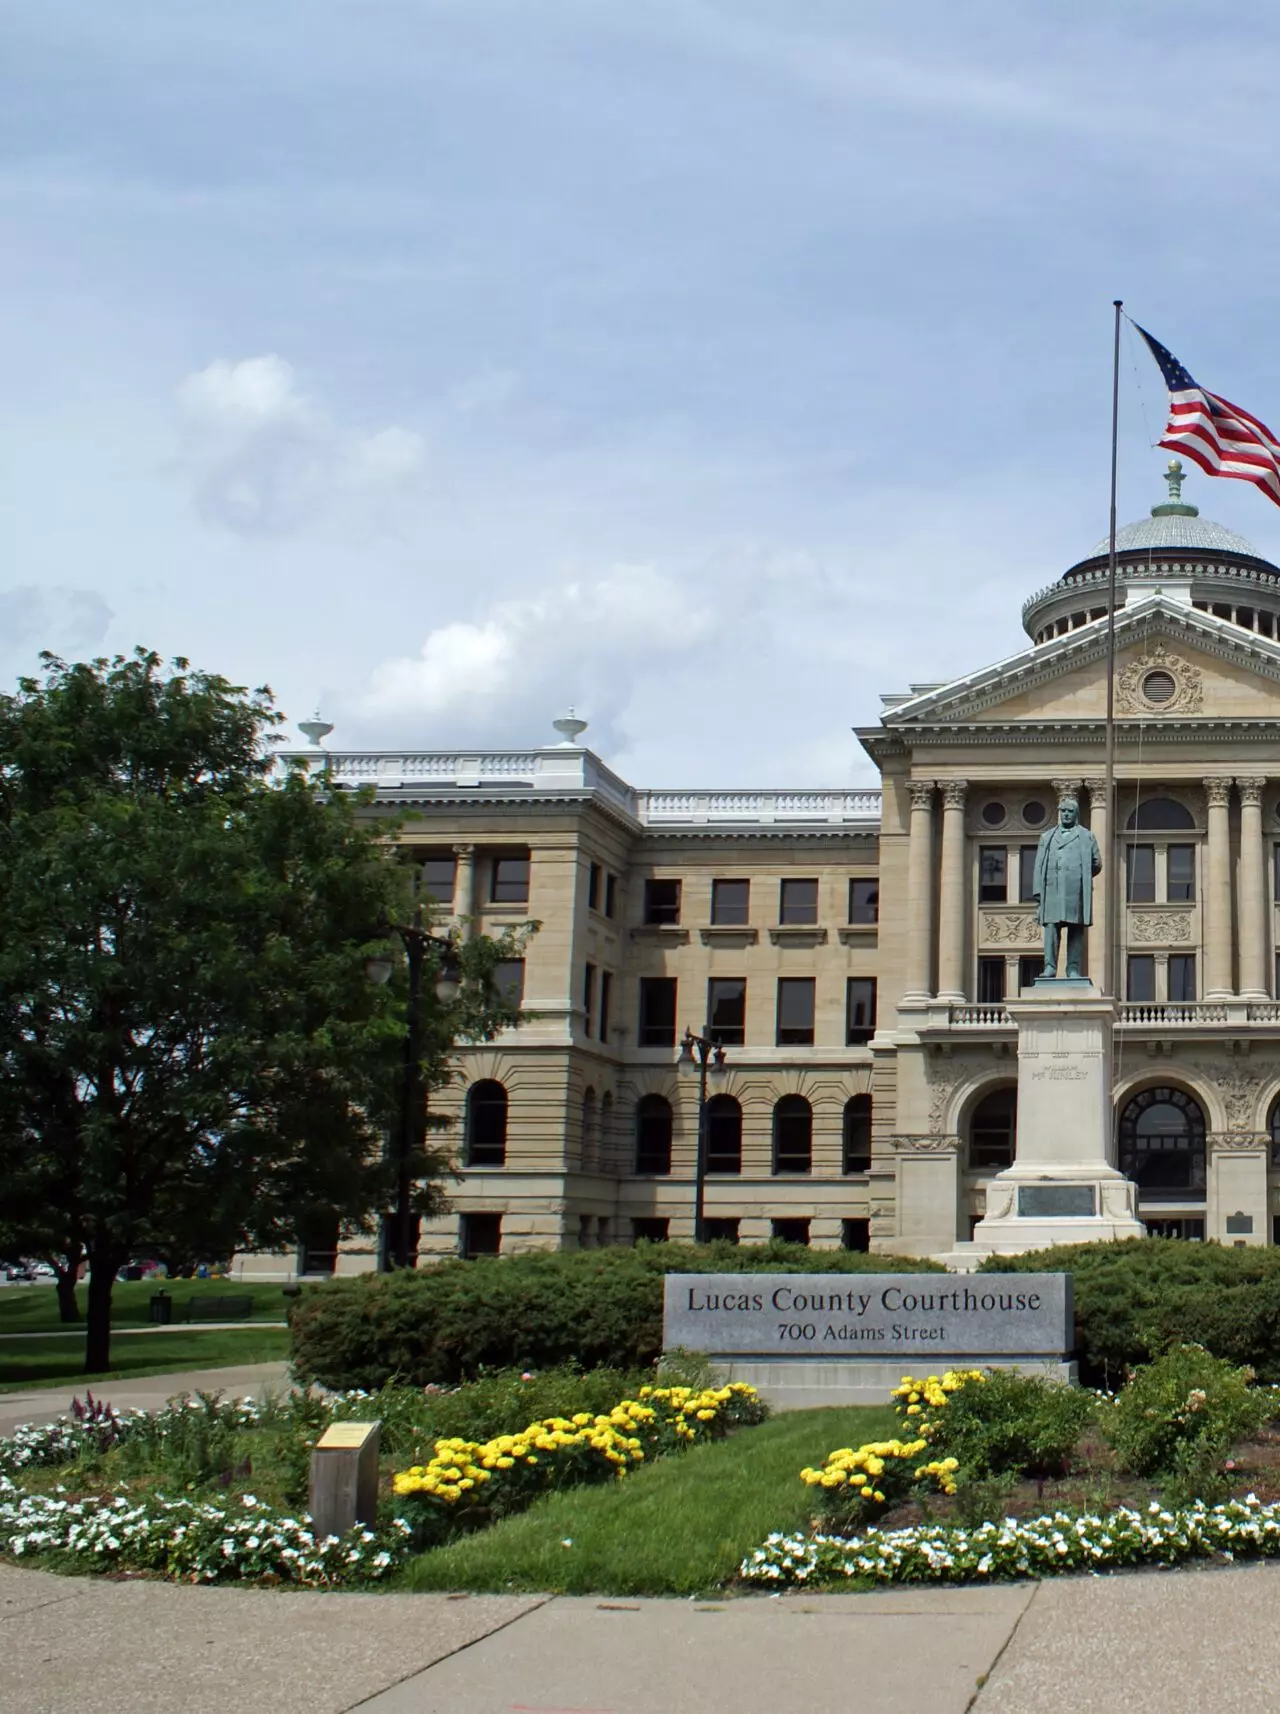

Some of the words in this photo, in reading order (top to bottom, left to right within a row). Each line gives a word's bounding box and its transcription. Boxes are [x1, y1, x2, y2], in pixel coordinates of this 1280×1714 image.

[688, 1288, 763, 1311] Lucas
[772, 1287, 871, 1316] County
[881, 1287, 1041, 1312] Courthouse
[778, 1323, 816, 1341] 700
[823, 1324, 885, 1341] Adams
[891, 1324, 946, 1341] Street
